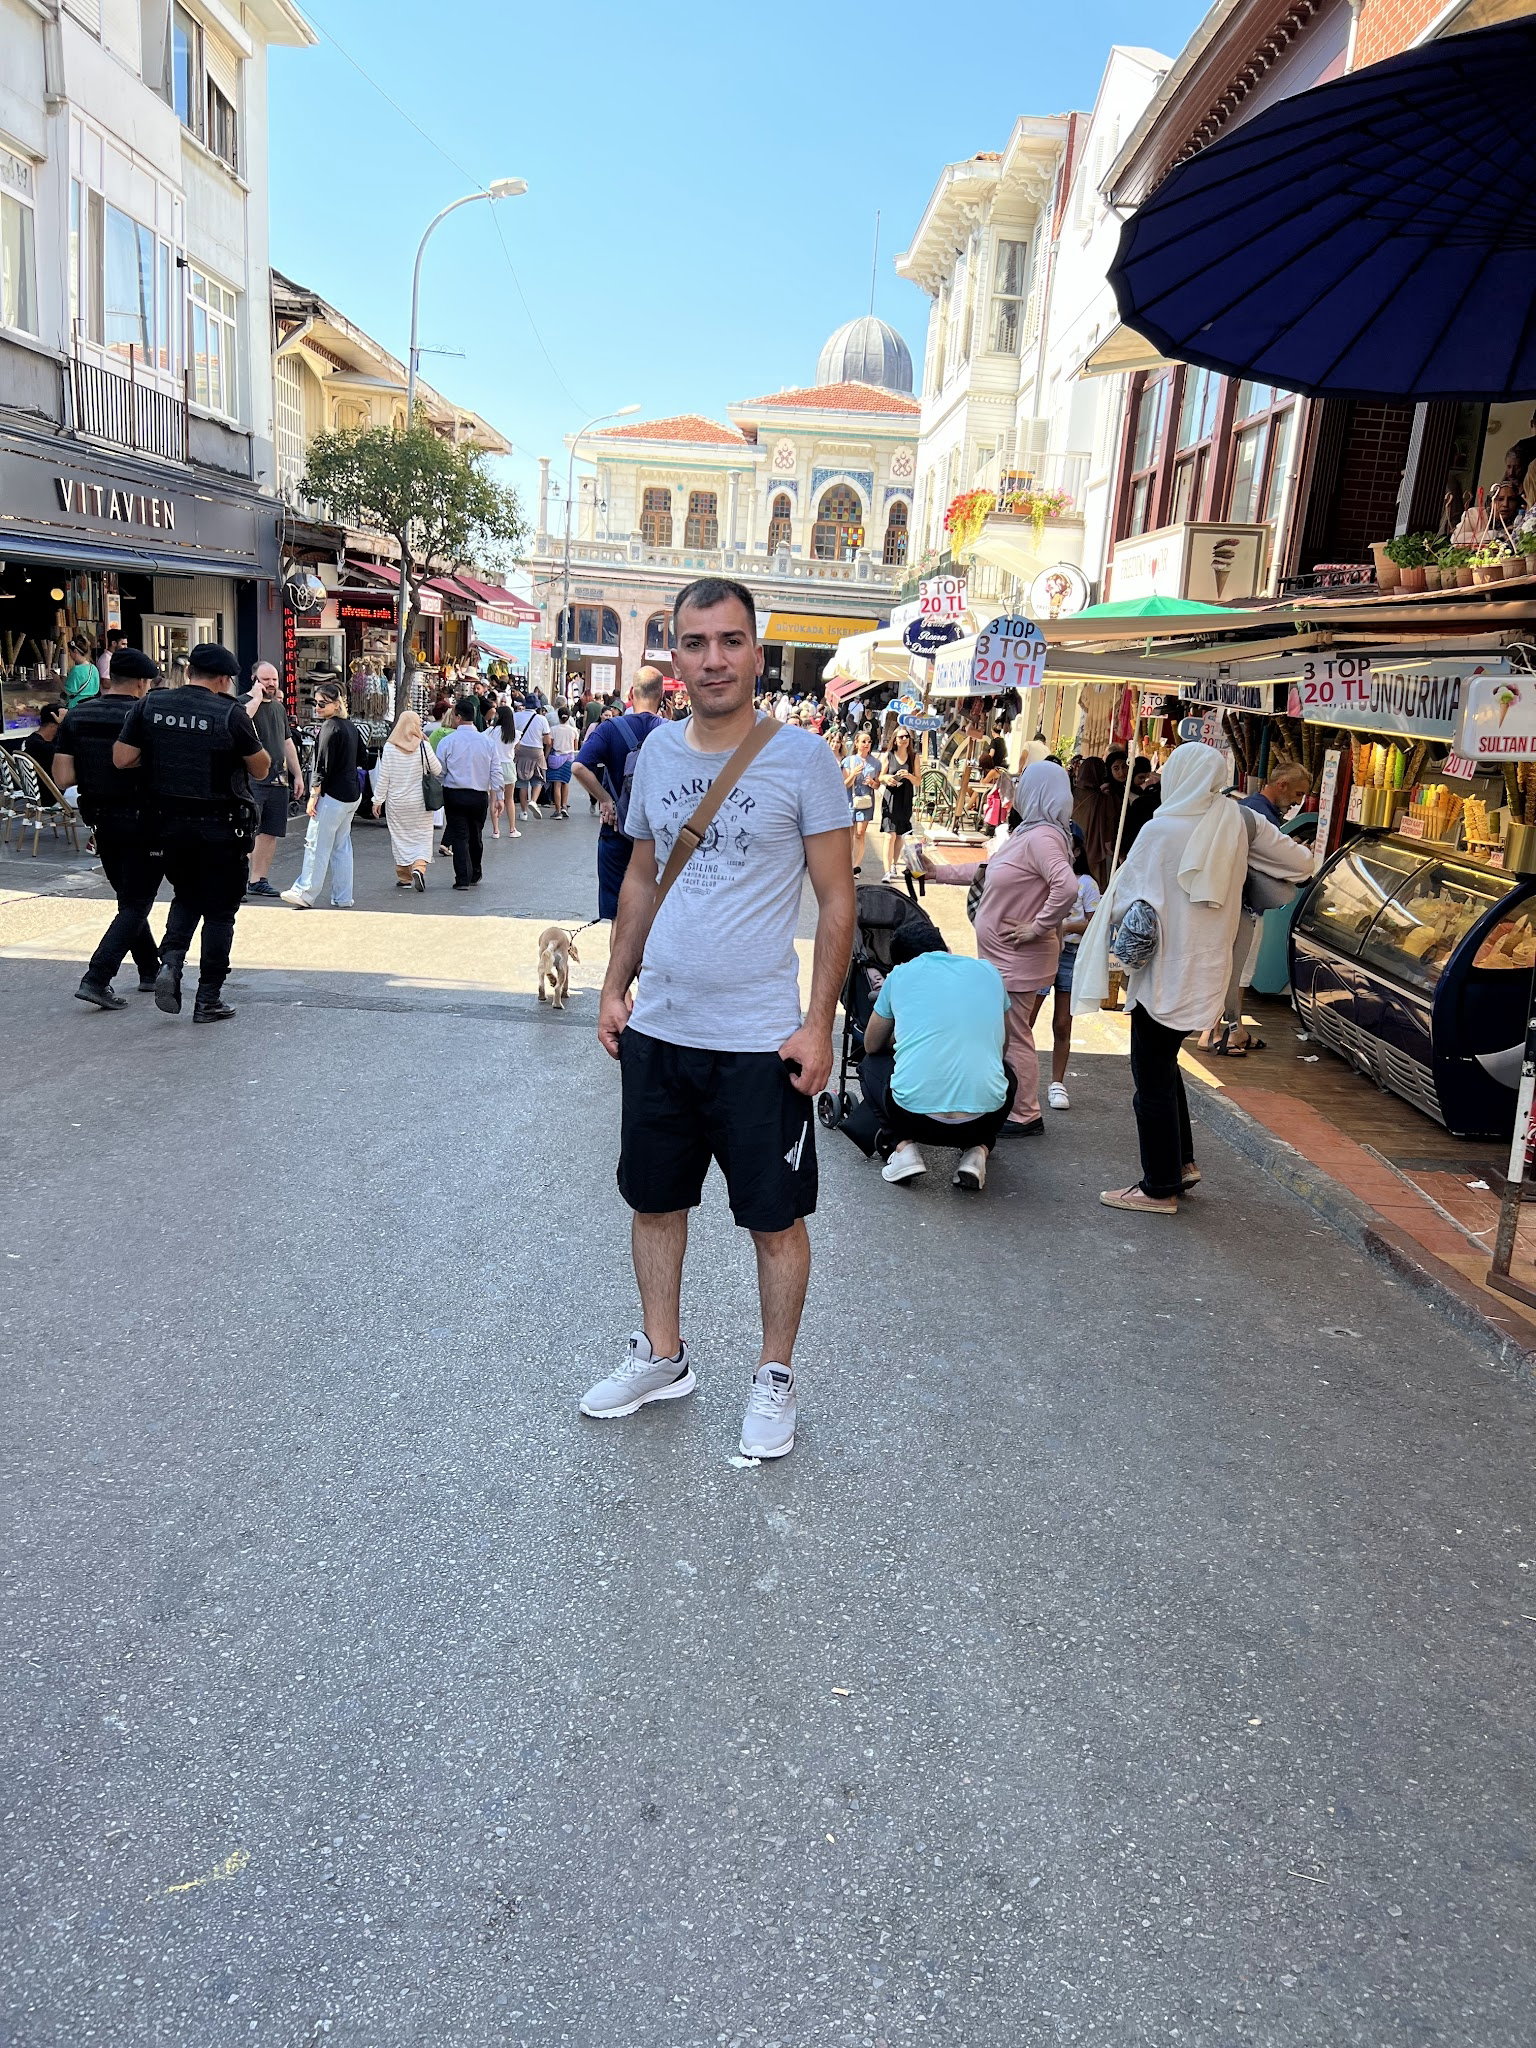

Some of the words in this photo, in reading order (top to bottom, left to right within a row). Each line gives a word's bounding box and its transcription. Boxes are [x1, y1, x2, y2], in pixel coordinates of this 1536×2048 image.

[59, 477, 176, 530] VITAVIEN
[920, 582, 928, 595] 3
[933, 579, 966, 595] TOP
[920, 597, 942, 613] 20
[946, 595, 967, 611] TL
[775, 621, 824, 635] BÜYÜKADA
[918, 631, 949, 641] Roma
[990, 619, 1000, 635] 3
[1004, 619, 1035, 638] TOP
[977, 635, 991, 655] 3
[999, 637, 1047, 662] TOP
[975, 658, 1006, 683] 20
[1013, 662, 1040, 686] TL
[1304, 662, 1316, 681] 3
[1323, 657, 1371, 679] TOP
[1304, 681, 1334, 703] 20
[1341, 679, 1370, 701] TL
[1360, 673, 1461, 721] ONDURMA
[908, 718, 937, 727] ROMA
[1479, 735, 1528, 753] SULTAN
[661, 778, 756, 815] MARIER
[687, 862, 719, 873] SAILING
